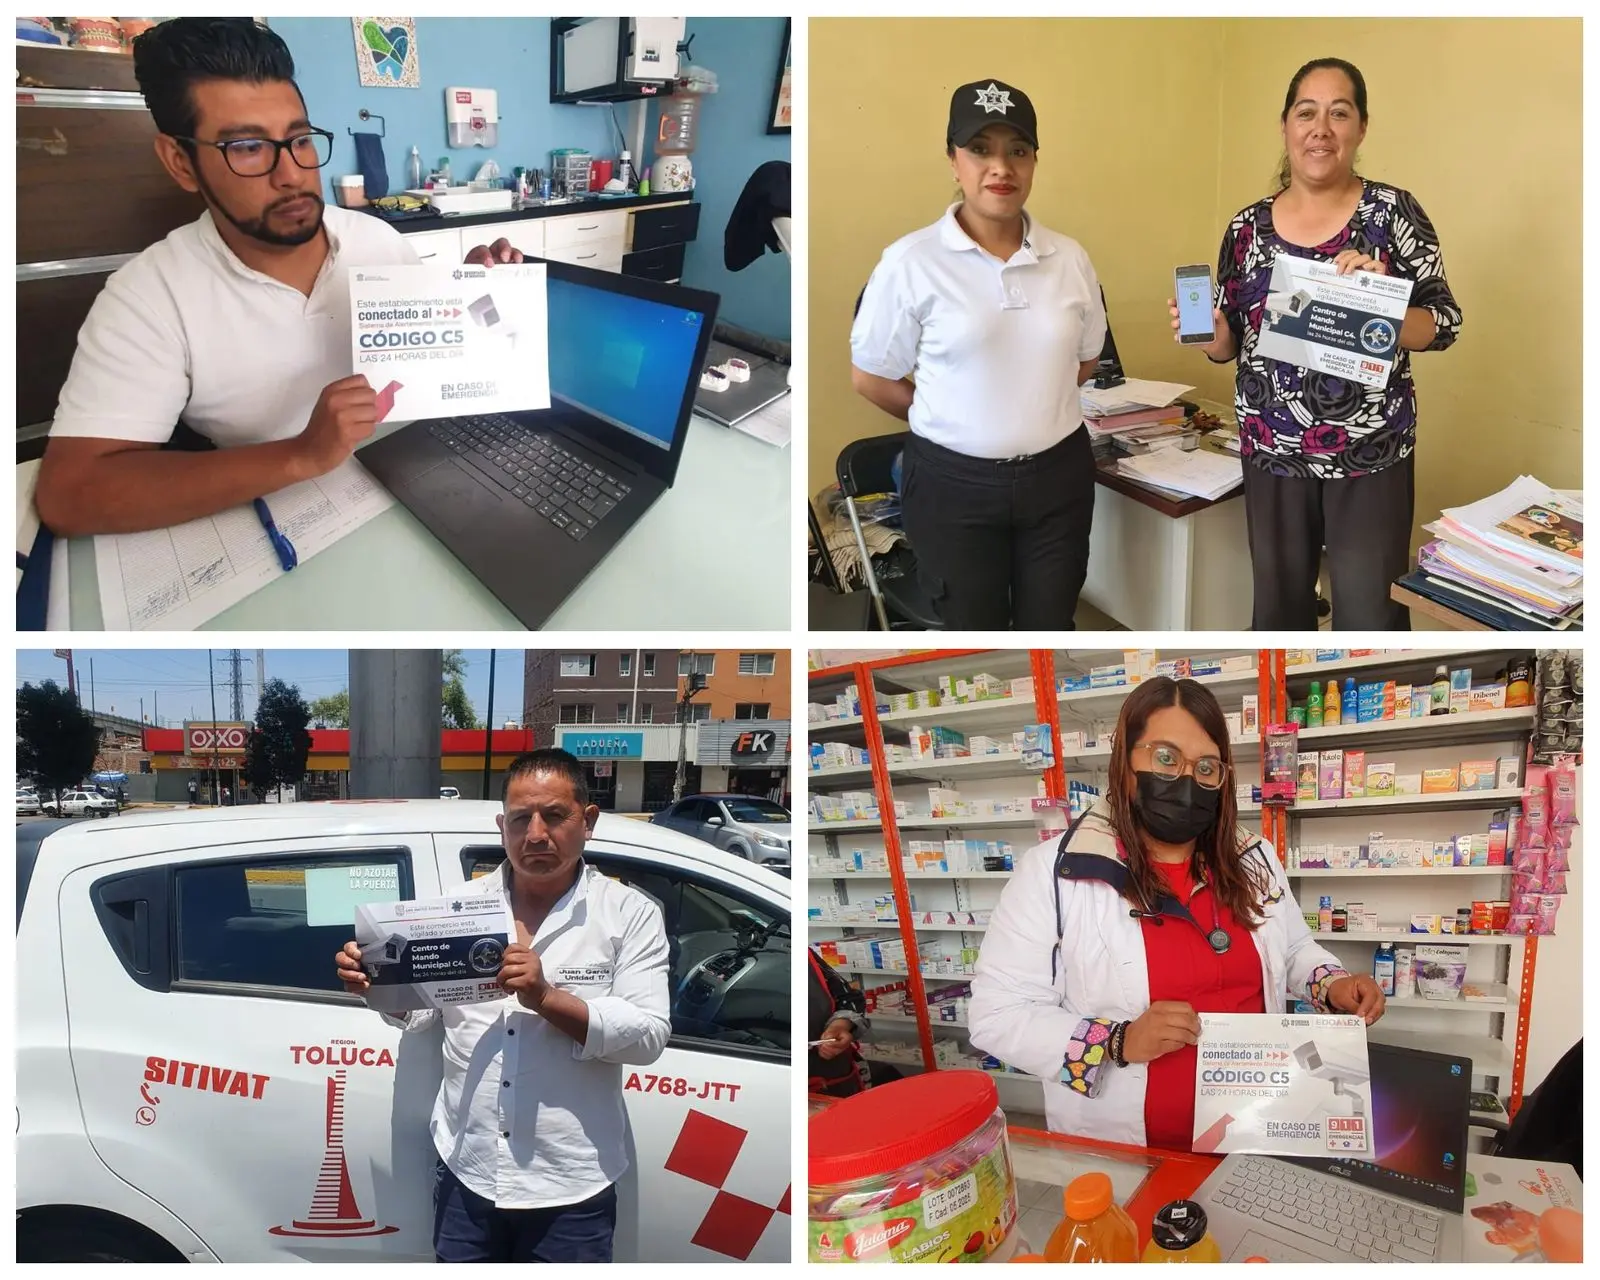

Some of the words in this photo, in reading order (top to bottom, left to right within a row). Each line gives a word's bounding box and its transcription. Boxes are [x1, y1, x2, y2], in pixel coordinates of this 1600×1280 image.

[1317, 286, 1330, 294] Este
[357, 299, 376, 308] Este
[378, 298, 443, 308] establecimiento
[358, 308, 418, 321] conectado
[422, 308, 432, 318] al
[1312, 306, 1336, 317] Centro
[1337, 310, 1347, 319] de
[1310, 314, 1335, 325] Mando
[1308, 322, 1343, 336] Municipal
[360, 330, 436, 348] CÓDIGO
[442, 330, 464, 343] C5
[359, 354, 378, 364] LAS
[380, 354, 392, 362] 24
[394, 351, 427, 361] HORAS
[429, 350, 446, 360] DEL
[1332, 354, 1348, 363] CASO
[441, 384, 454, 392] EN
[457, 382, 483, 391] CASO
[1474, 690, 1500, 699] Dibenel
[192, 729, 244, 748] OXXO
[737, 732, 771, 752] FK
[350, 868, 361, 878] NO
[364, 867, 397, 877] AZOTAR
[350, 880, 360, 889] LA
[364, 880, 396, 889] PUERTA
[426, 922, 459, 930] comercio
[410, 930, 438, 938] vigilado
[445, 926, 482, 935] conectado
[411, 944, 439, 952] Centro
[412, 953, 439, 962] Mando
[412, 961, 451, 970] Municipal
[435, 991, 473, 999] EMERGENCIA
[290, 1046, 395, 1067] TOLUCA
[1202, 1050, 1252, 1060] conectado
[1254, 1050, 1263, 1060] al
[144, 1056, 270, 1100] SITIVAT
[1202, 1068, 1266, 1083] CÓDIGO
[1270, 1072, 1289, 1084] C5
[624, 1072, 741, 1102] A768-JTT
[1217, 1089, 1227, 1097] 24
[1228, 1089, 1256, 1097] HORAS
[1258, 1089, 1273, 1097] DEL
[1276, 1088, 1289, 1097] DÍA
[1267, 1122, 1279, 1130] EN
[1281, 1122, 1306, 1131] CASO
[1308, 1123, 1320, 1131] DE
[1330, 1120, 1362, 1130] 911
[1267, 1130, 1320, 1139] EMERGENCIA
[1328, 1165, 1352, 1176] ASUS
[819, 1232, 832, 1248] 4
[903, 1230, 951, 1259] LABIOS
